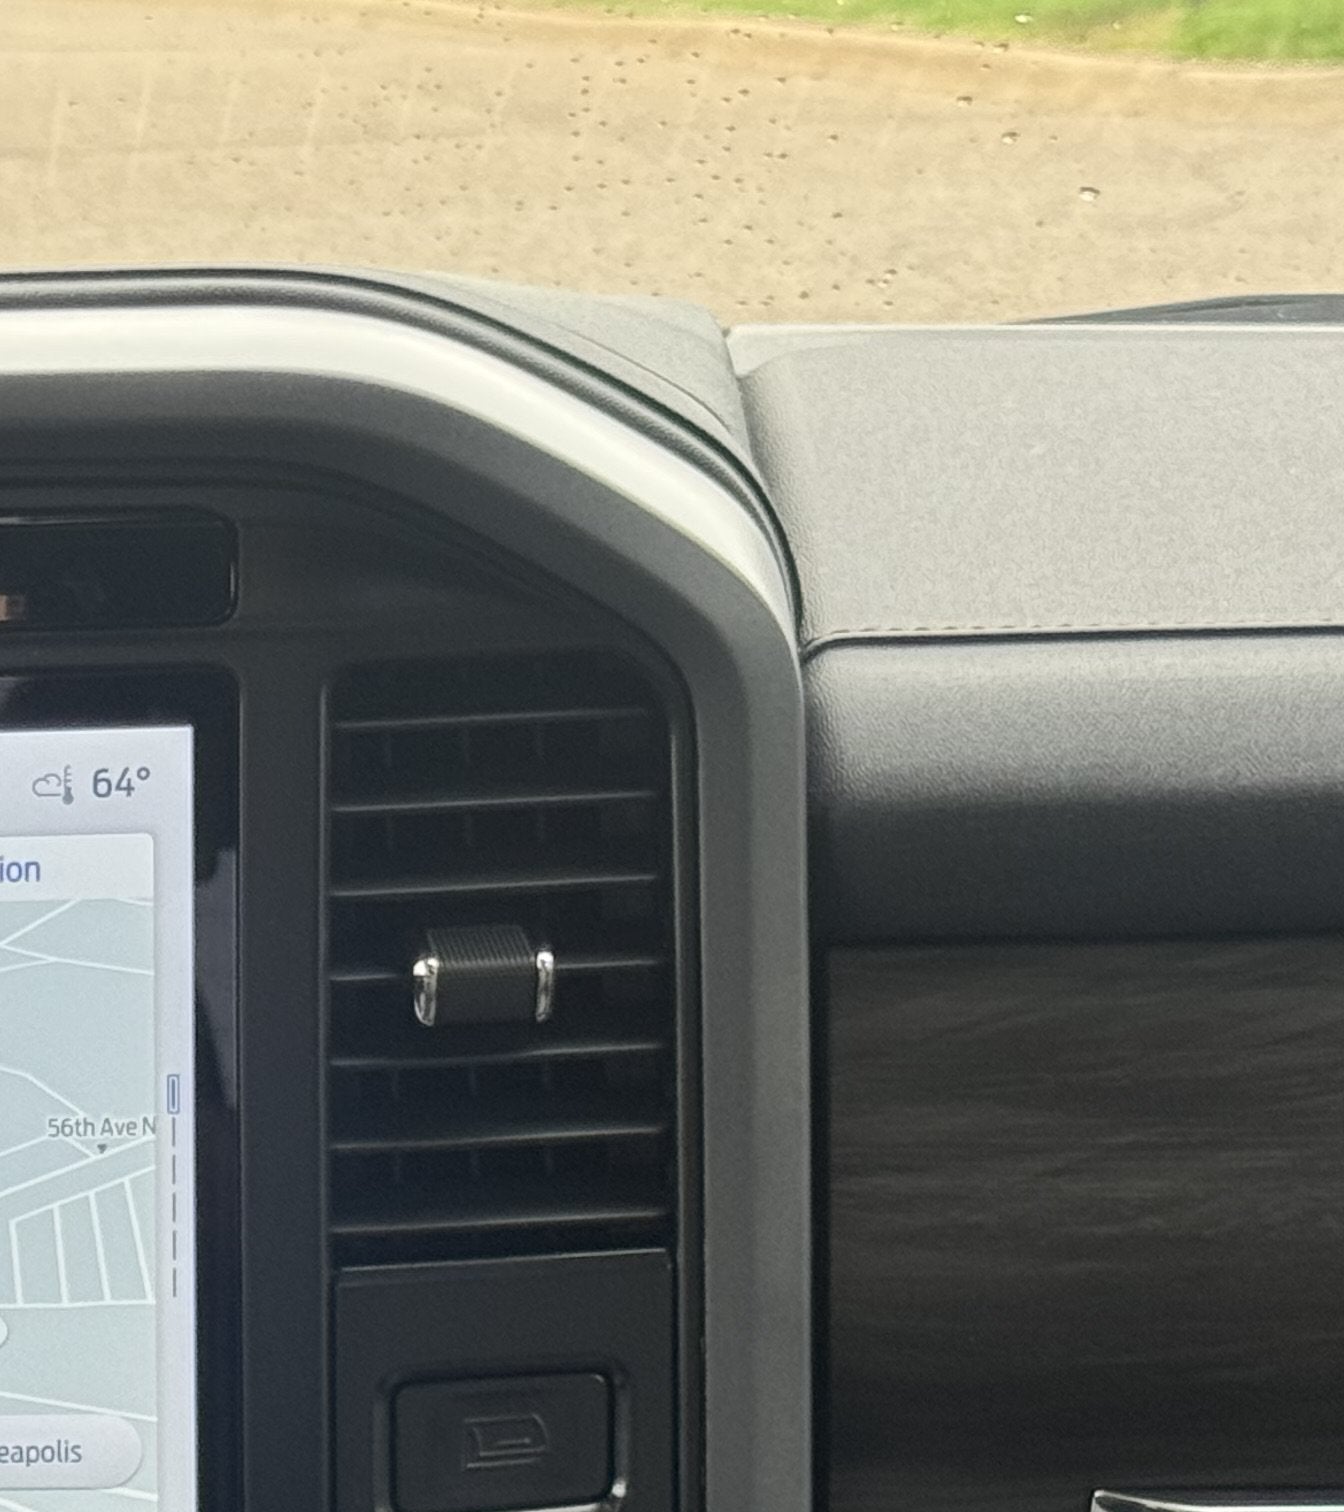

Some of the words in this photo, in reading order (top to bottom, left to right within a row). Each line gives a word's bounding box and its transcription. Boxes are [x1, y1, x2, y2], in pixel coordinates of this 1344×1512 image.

[47, 1116, 95, 1139] 56th
[100, 1117, 139, 1138] Ave
[141, 1116, 157, 1137] N
